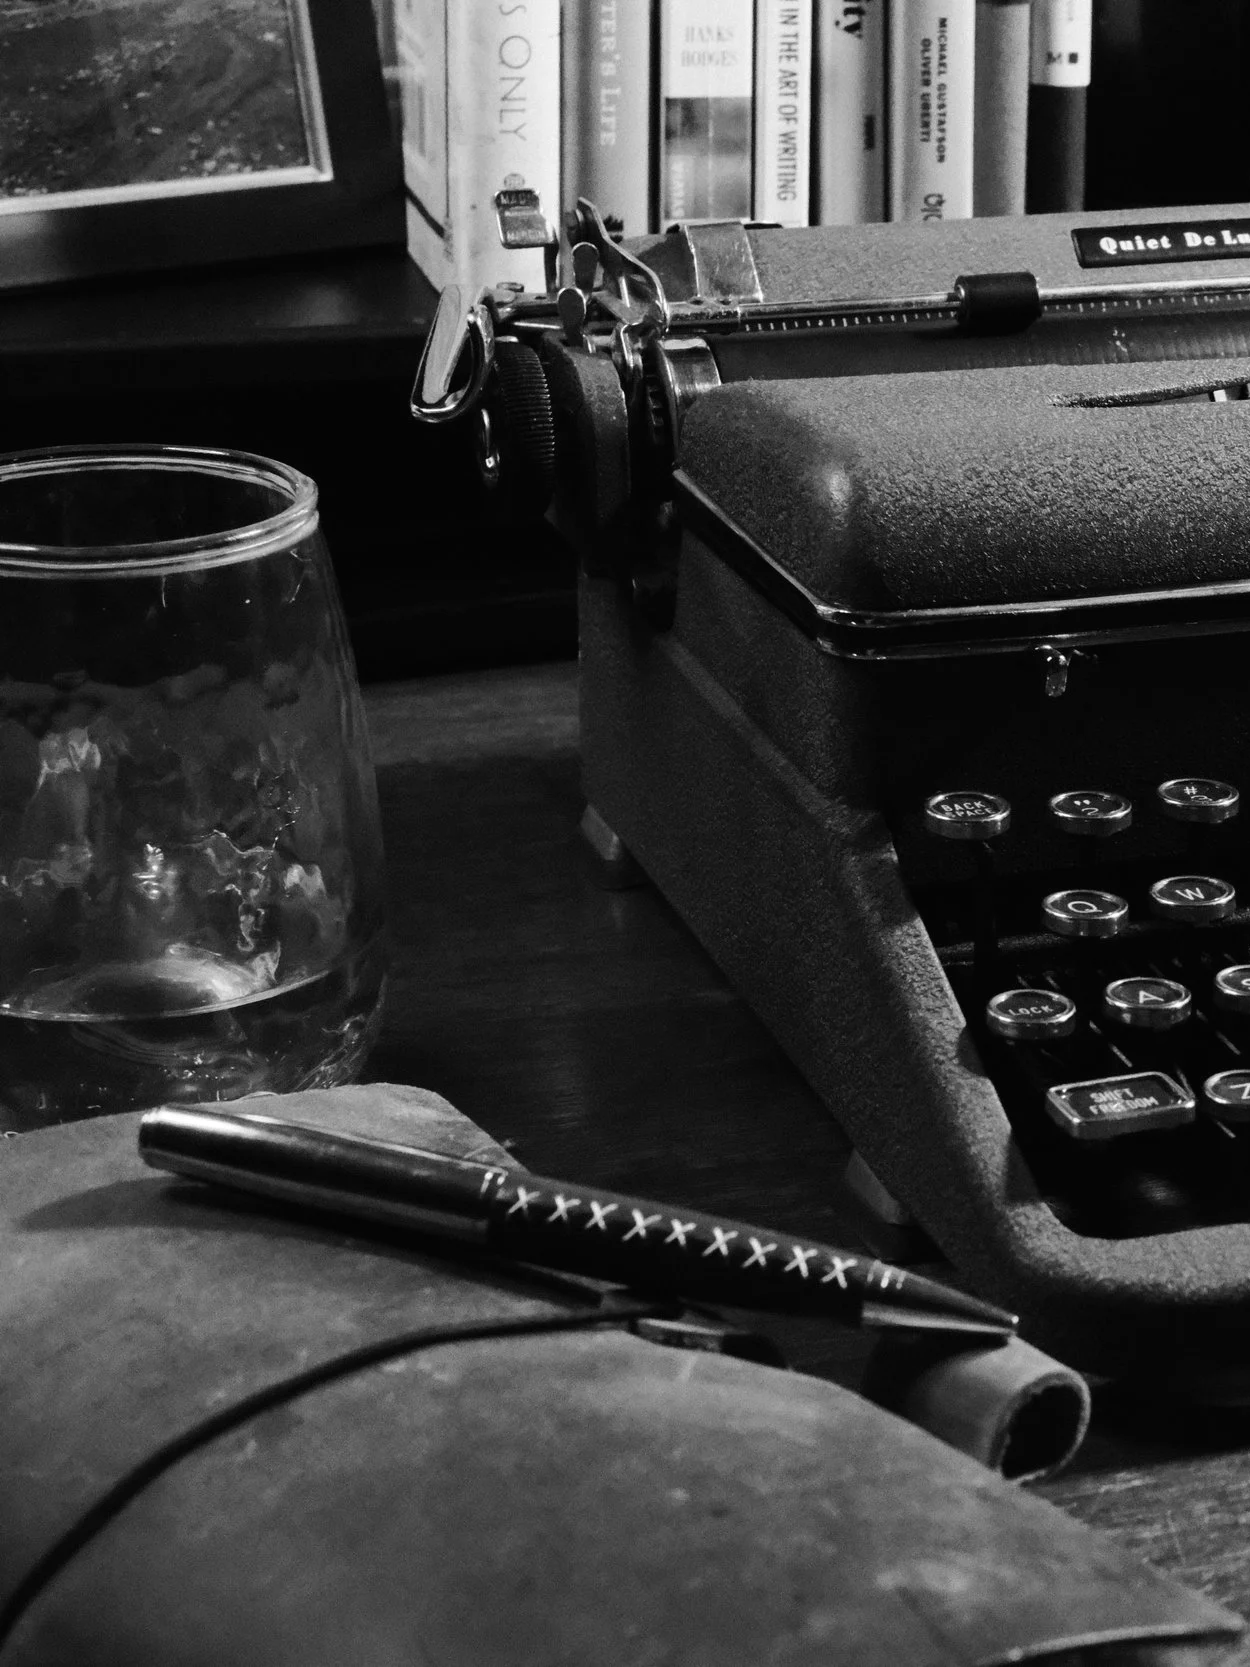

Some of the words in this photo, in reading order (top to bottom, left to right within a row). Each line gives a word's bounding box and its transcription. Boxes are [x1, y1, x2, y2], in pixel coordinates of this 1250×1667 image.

[779, 8, 799, 26] IN
[778, 32, 798, 63] THE
[937, 17, 947, 77] MICHAEL
[920, 38, 932, 87] OLIVER
[499, 35, 531, 141] ONLY
[778, 68, 798, 97] ART
[777, 104, 798, 125] OF
[936, 83, 947, 163] GUSTAFSON
[776, 130, 797, 202] WRITING
[1100, 235, 1172, 255] Quiet
[1183, 231, 1217, 248] De
[941, 801, 986, 812] BACK
[945, 808, 997, 818] SPACE
[1174, 886, 1206, 901] W
[1067, 900, 1103, 914] Q
[1138, 990, 1165, 1004] A
[1008, 1005, 1054, 1017] LOCK
[1089, 1088, 1134, 1103] SHIFT
[1089, 1096, 1160, 1115] FREEDOM
